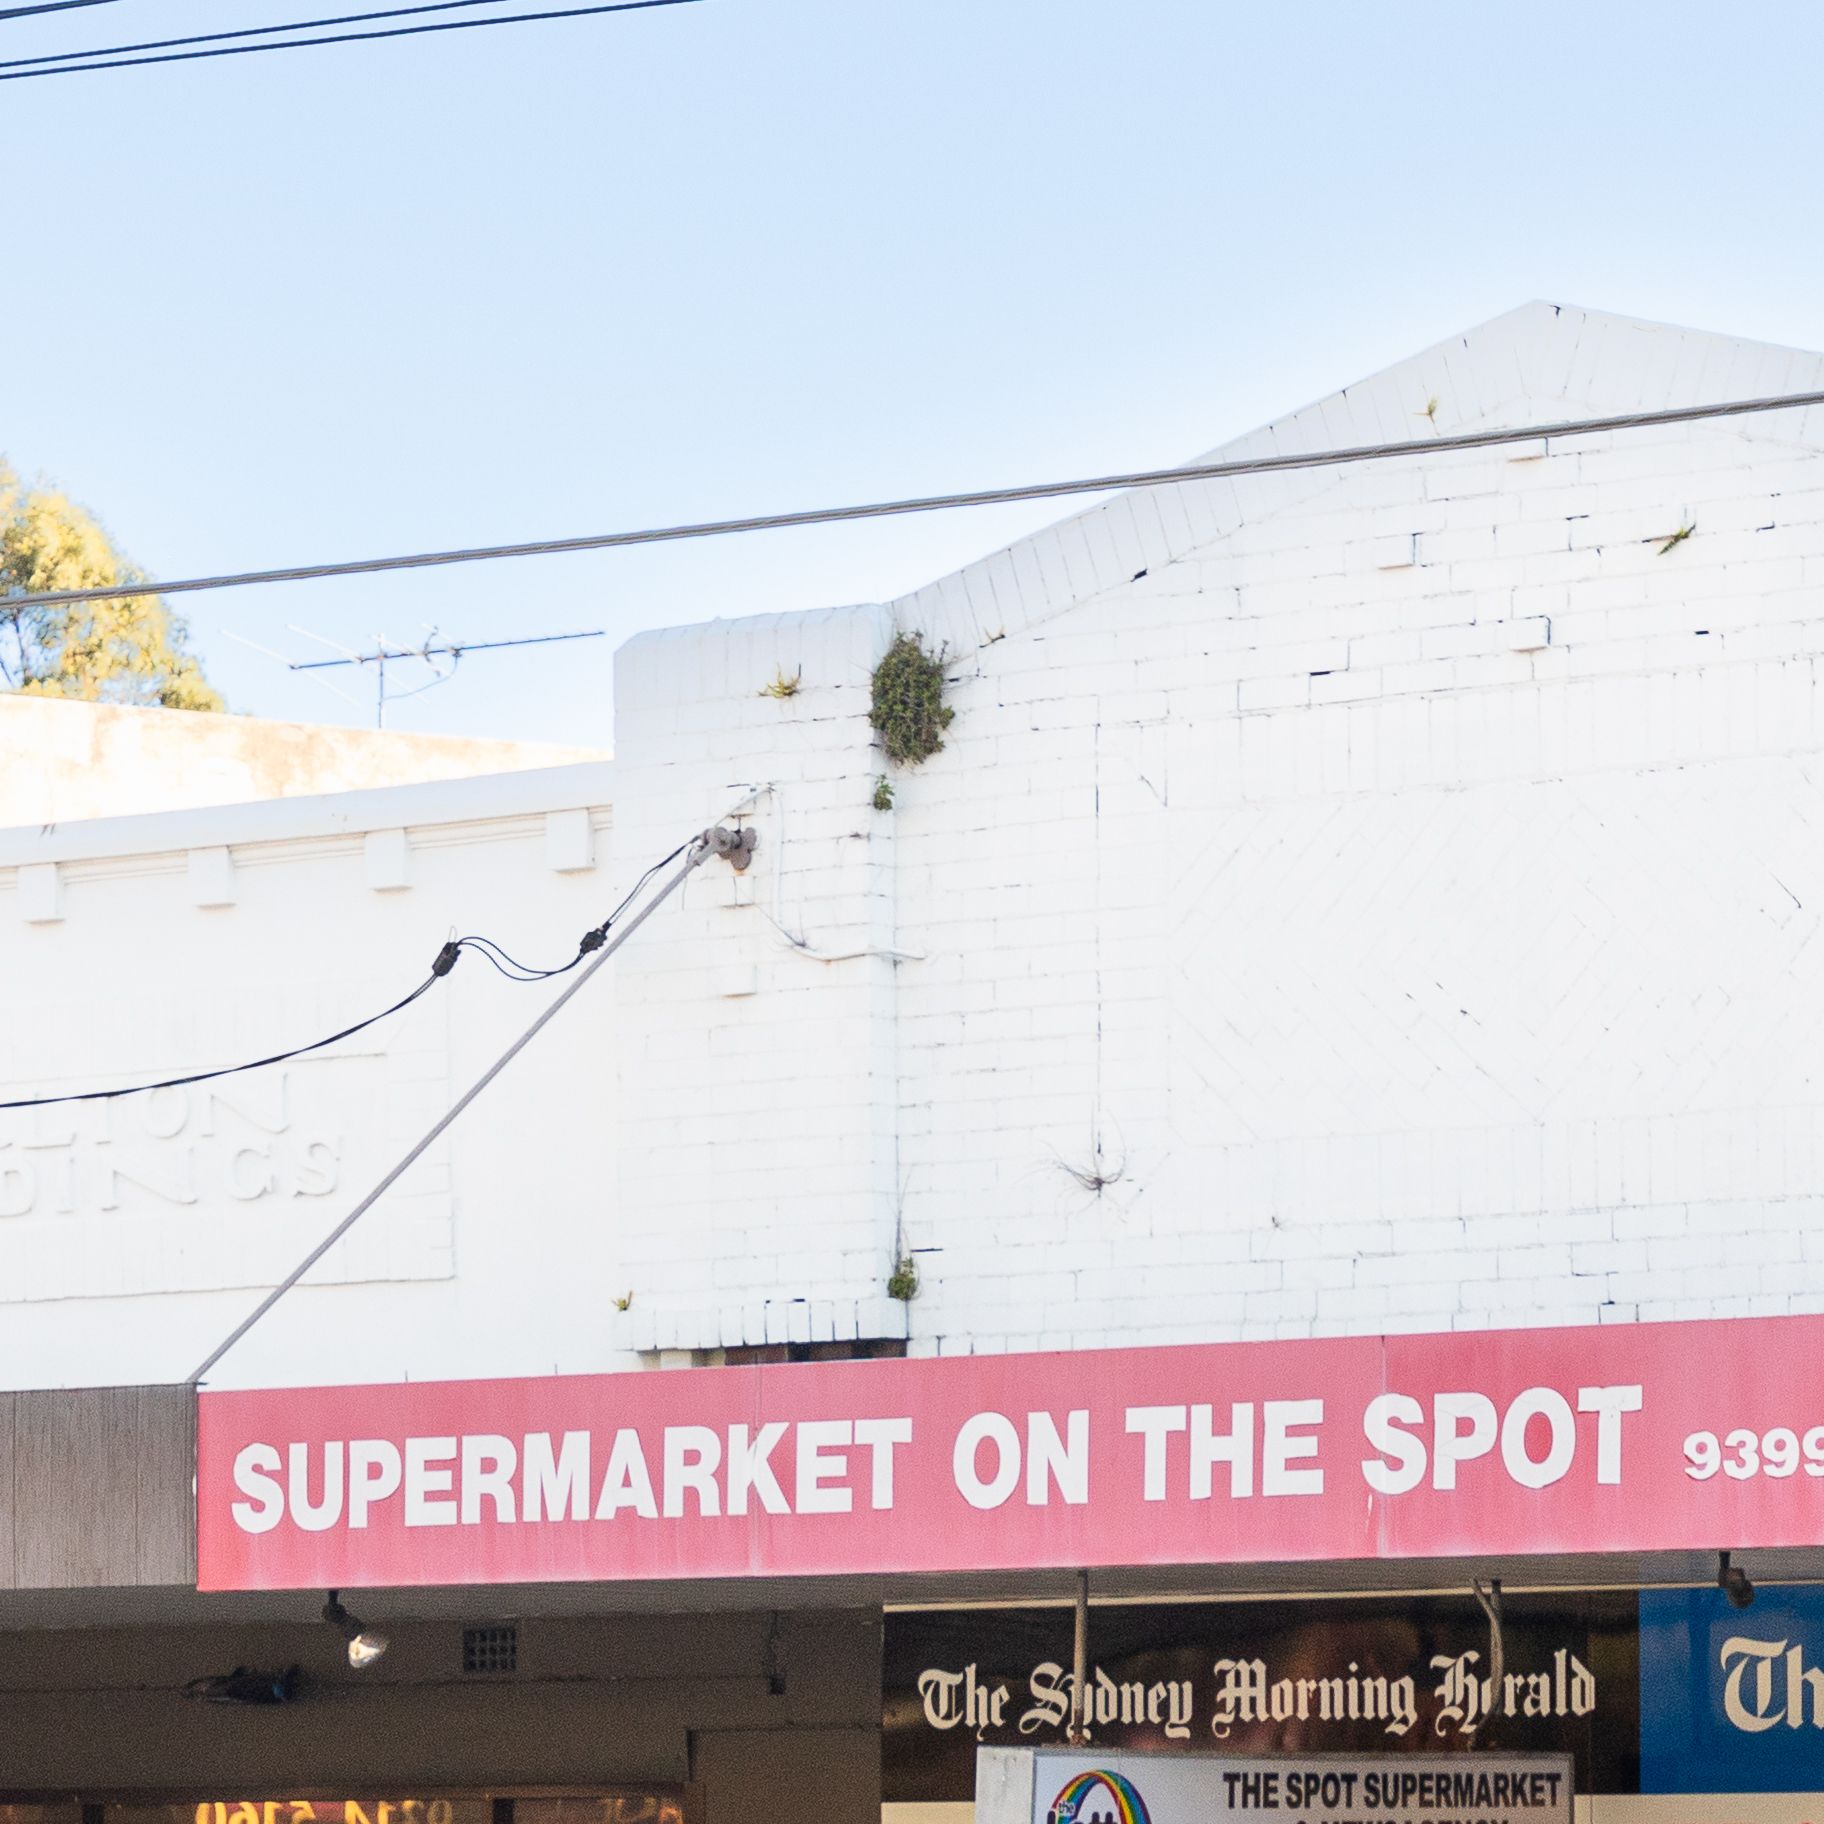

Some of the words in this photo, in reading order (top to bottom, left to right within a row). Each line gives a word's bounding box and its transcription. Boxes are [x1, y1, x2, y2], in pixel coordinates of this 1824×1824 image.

[231, 1416, 914, 1535] SUPERMARKET
[952, 1408, 1090, 1511] ON
[1125, 1397, 1325, 1504] THE
[1362, 1383, 1644, 1496] SPOT
[917, 1661, 1011, 1744] The
[1212, 1656, 1418, 1740] Morning
[1223, 1772, 1282, 1810] THE
[1285, 1771, 1360, 1810] SPOT
[1364, 1771, 1563, 1810] SUPERMARKET
